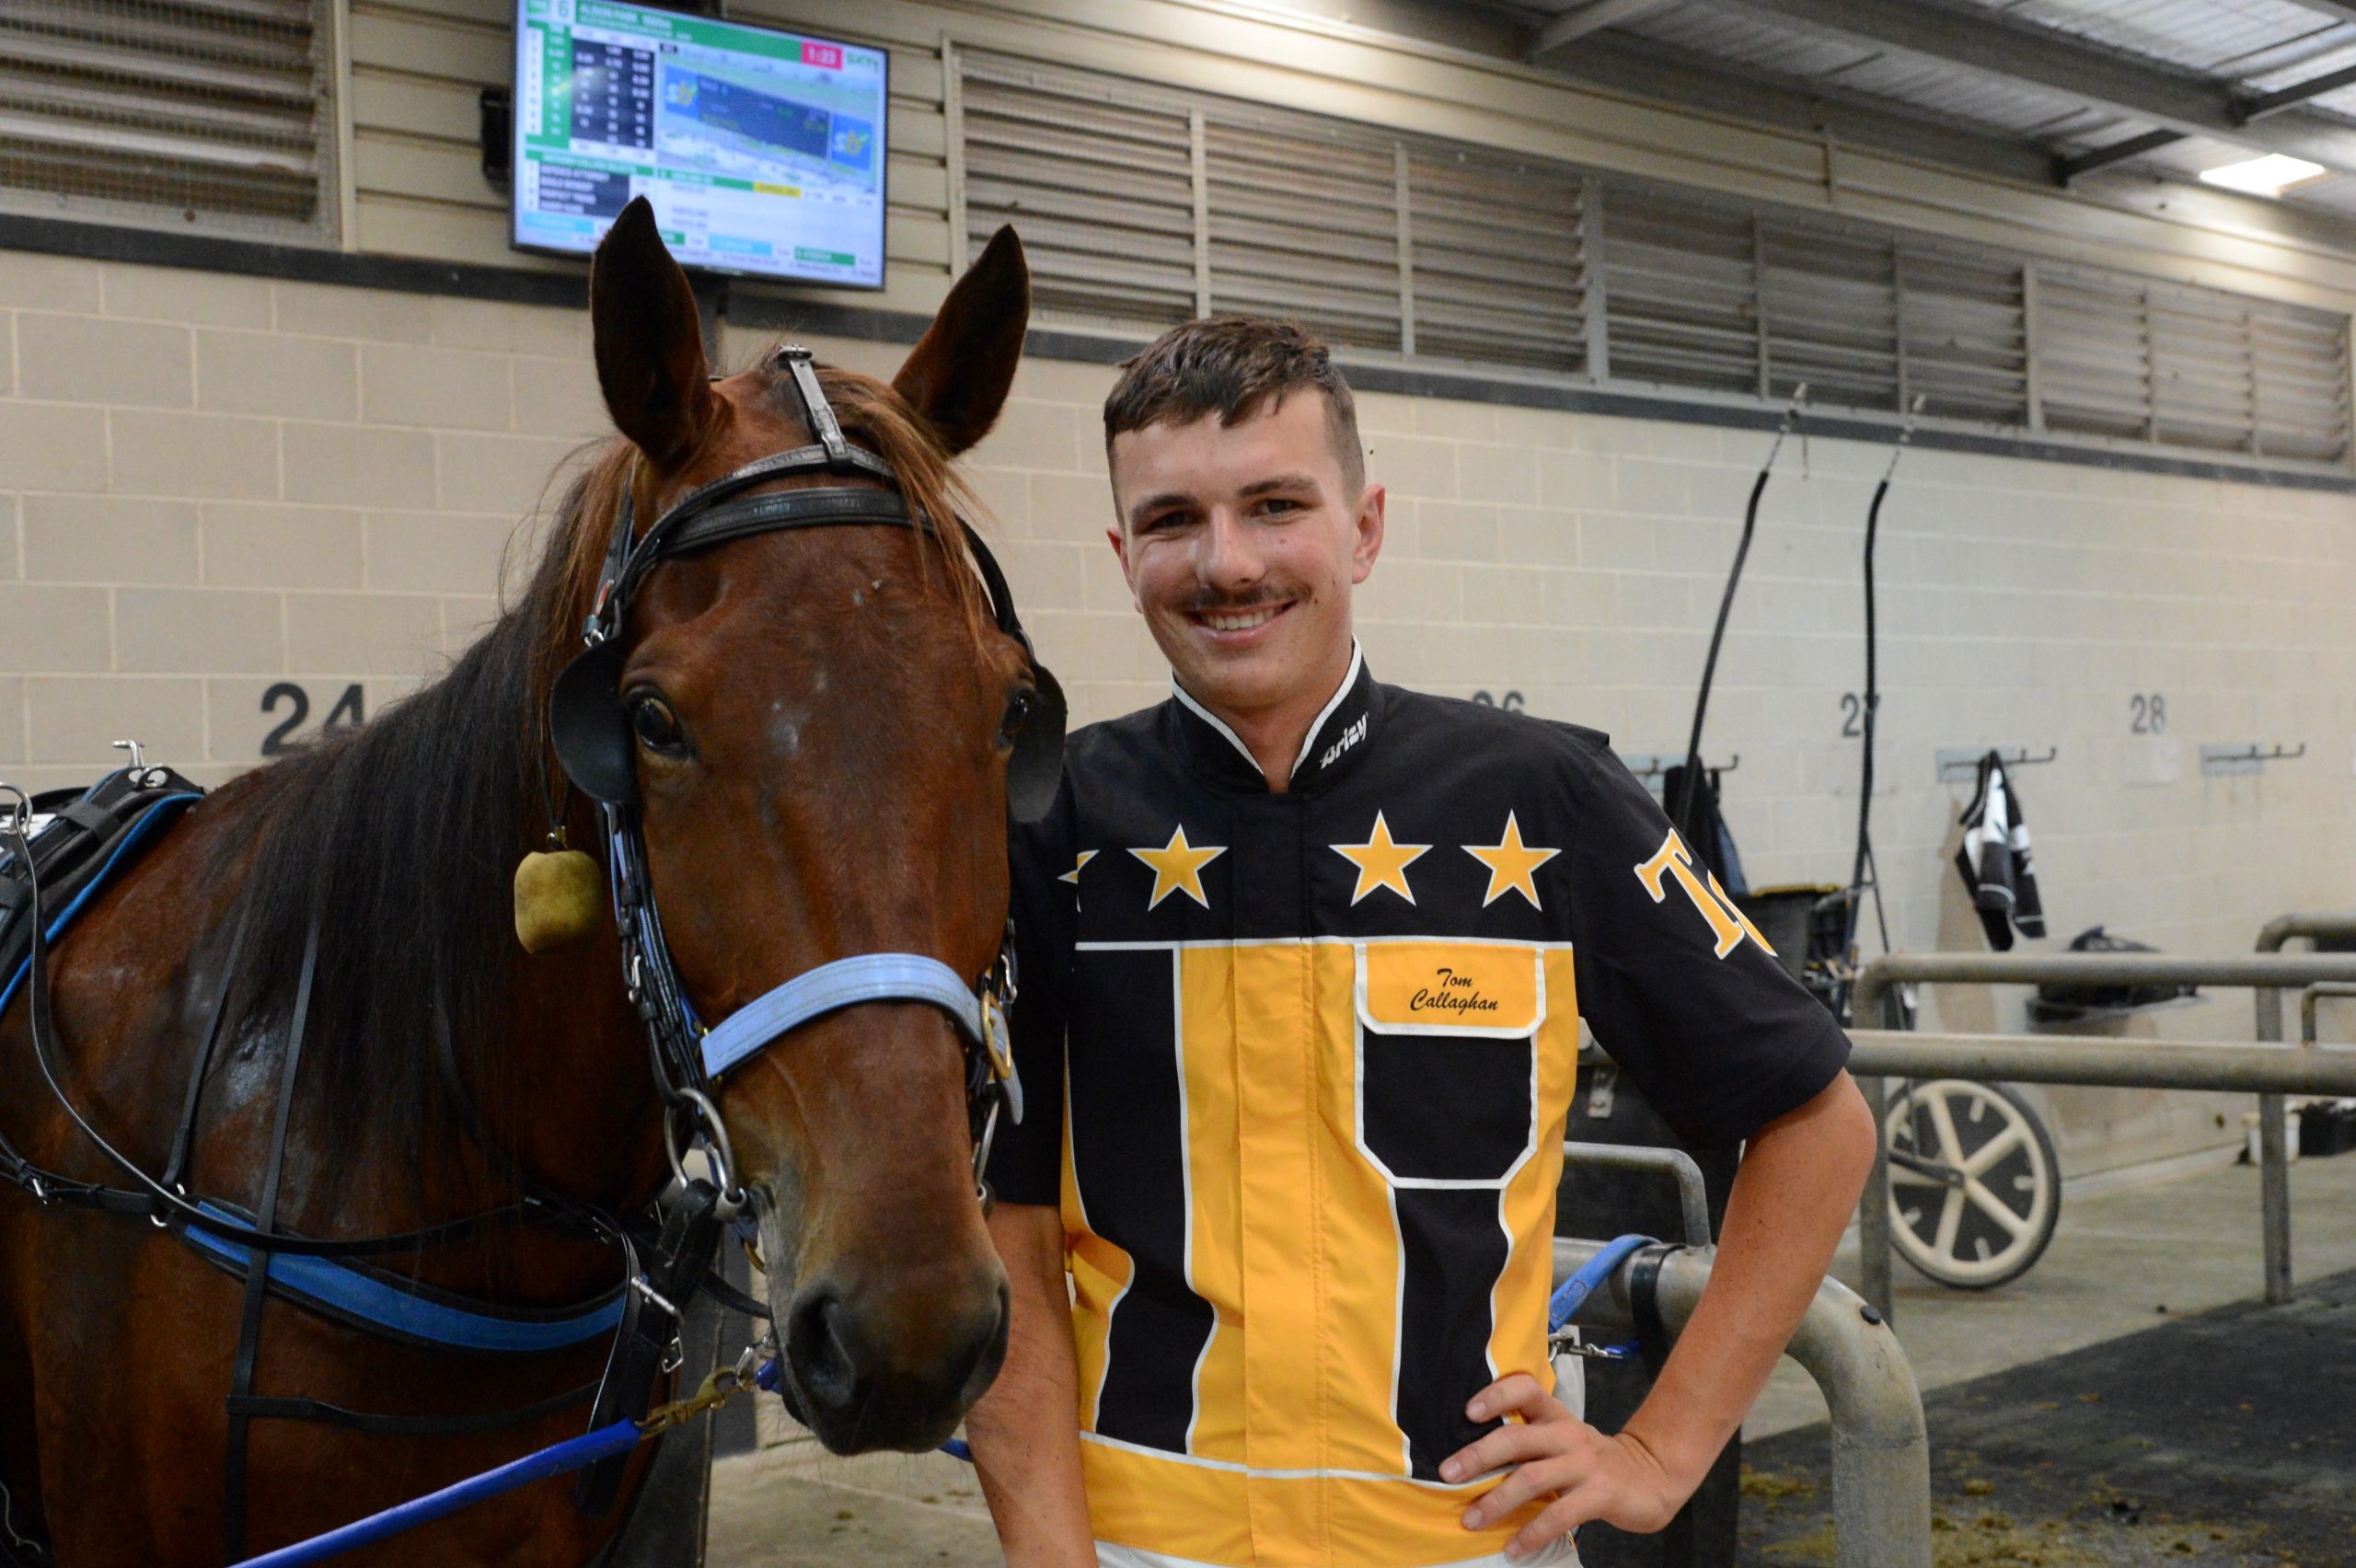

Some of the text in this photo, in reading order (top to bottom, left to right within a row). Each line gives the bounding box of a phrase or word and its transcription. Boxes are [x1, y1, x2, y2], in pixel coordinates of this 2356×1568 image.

[2130, 694, 2166, 734] 28
[1437, 968, 1473, 988] Tom
[1410, 988, 1498, 1015] Callaghan
